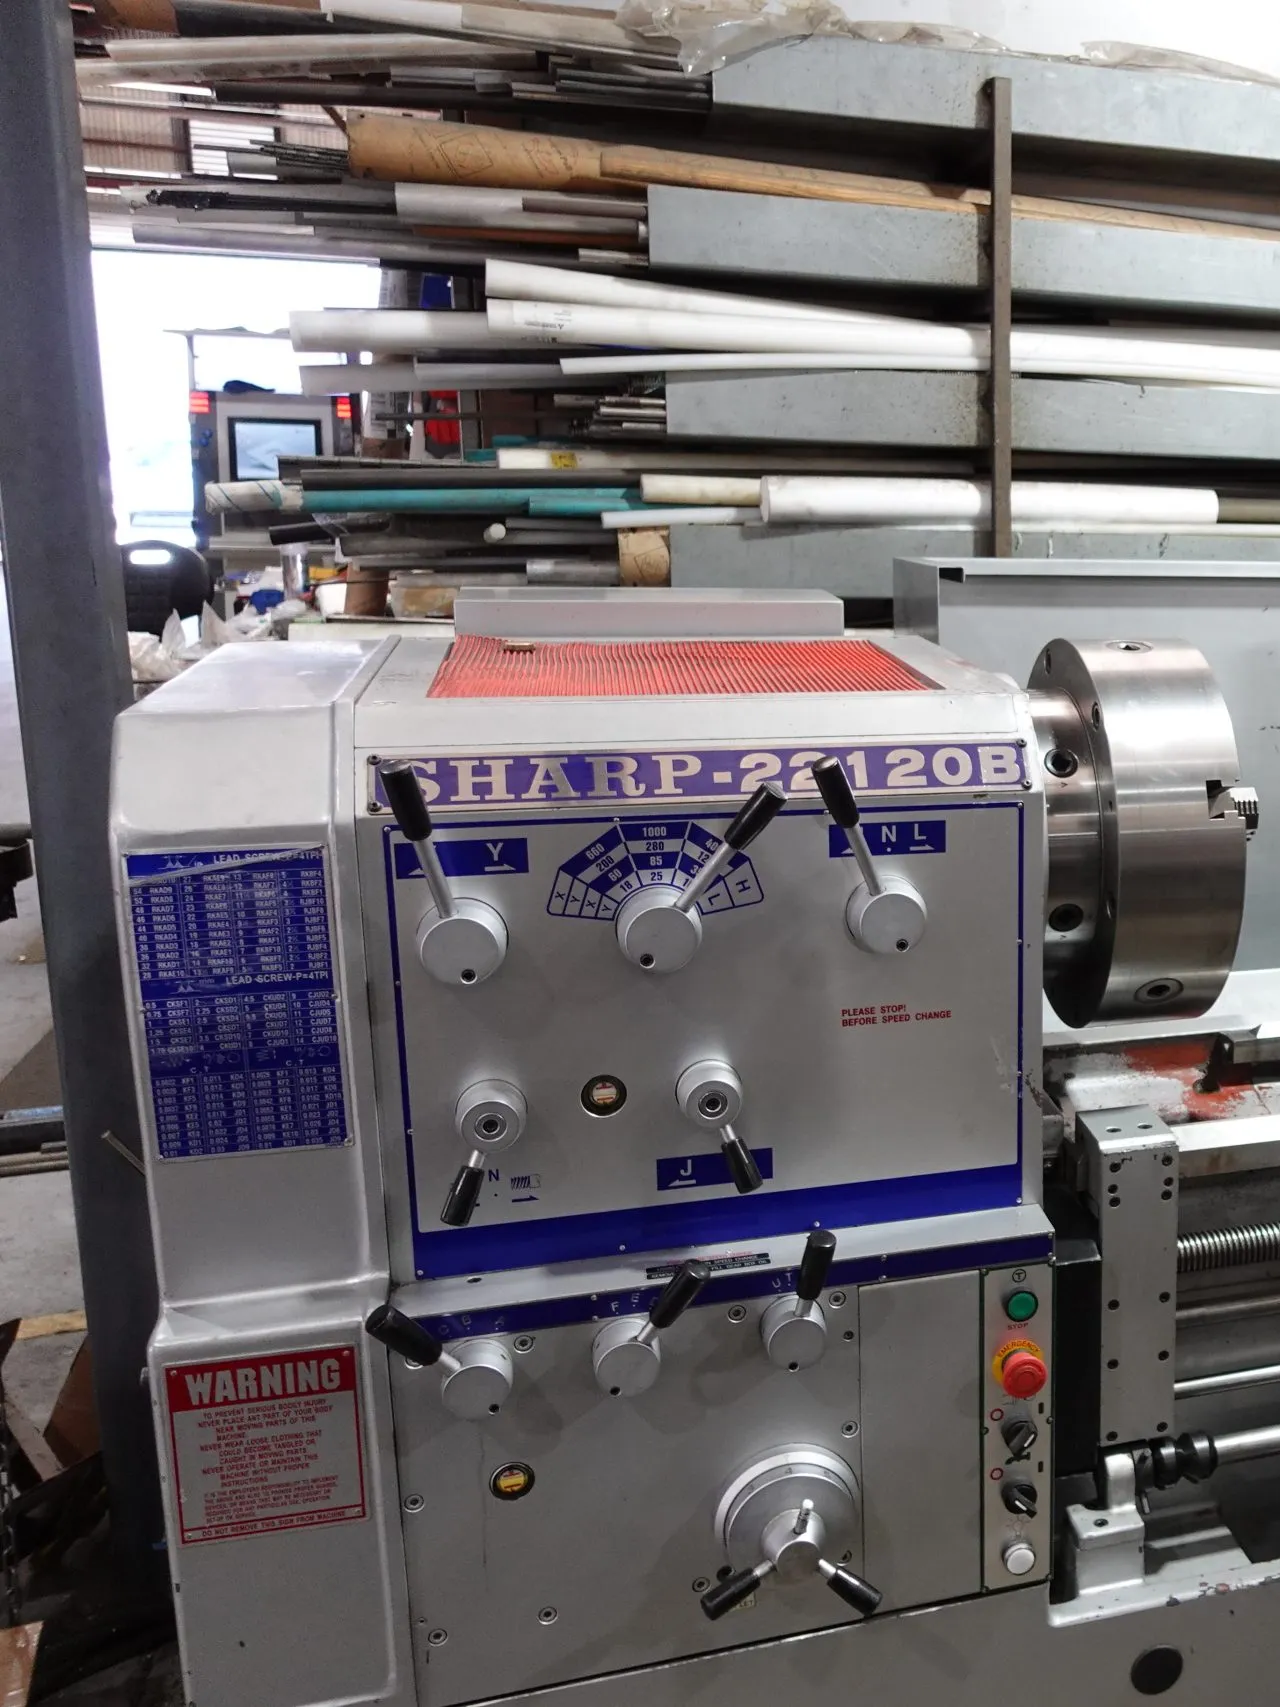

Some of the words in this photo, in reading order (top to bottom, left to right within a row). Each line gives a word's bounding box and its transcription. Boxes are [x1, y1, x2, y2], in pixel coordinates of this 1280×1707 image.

[642, 826, 667, 838] 1000
[882, 825, 896, 843] N
[914, 824, 926, 840] L
[646, 842, 664, 852] 280
[705, 838, 719, 851] 40
[486, 842, 504, 862] Y
[585, 843, 605, 860] 660
[698, 852, 710, 863] 12
[596, 855, 615, 872] 200
[650, 856, 662, 866] 85
[608, 868, 622, 882] 60
[650, 871, 662, 881] 25
[620, 880, 633, 893] 18
[736, 879, 751, 893] H
[555, 891, 566, 900] X
[708, 893, 720, 906] L
[586, 900, 596, 909] X
[225, 974, 252, 985] LEAD
[842, 1007, 876, 1017] PLEASE
[880, 1004, 906, 1014] STOP!
[842, 1017, 877, 1027] BEFORE
[882, 1014, 905, 1024] SPEED
[910, 1010, 952, 1021] CHANGE
[680, 1160, 692, 1177] J
[488, 1169, 500, 1182] N
[772, 1278, 781, 1288] U
[1007, 1322, 1028, 1331] STOP
[997, 1340, 1041, 1358] EMERGENCY
[184, 1358, 341, 1406] WARNING
[198, 1419, 220, 1428] NEVER
[222, 1416, 244, 1425] PLACE
[294, 1407, 312, 1415] YOUR
[214, 1408, 243, 1418] PREVENT
[215, 1425, 233, 1434] NEAR
[237, 1421, 263, 1431] MOVING
[265, 1418, 286, 1427] PARTS
[301, 1414, 315, 1423] THIS
[199, 1442, 221, 1451] NEVER
[306, 1429, 322, 1437] THAT
[216, 1431, 245, 1441] MACHINE
[219, 1448, 241, 1456] COULD
[274, 1439, 303, 1449] TANGLED
[219, 1455, 246, 1464] CAUGHT
[202, 1465, 224, 1474] NEVER
[226, 1461, 256, 1471] OPERATE
[220, 1475, 268, 1488] INSTRUCTIONS
[230, 1522, 257, 1532] REMOVE
[260, 1520, 275, 1528] THIS
[278, 1517, 294, 1525] SIGN
[295, 1514, 314, 1523] FROM
[316, 1510, 345, 1520] MACHINE
